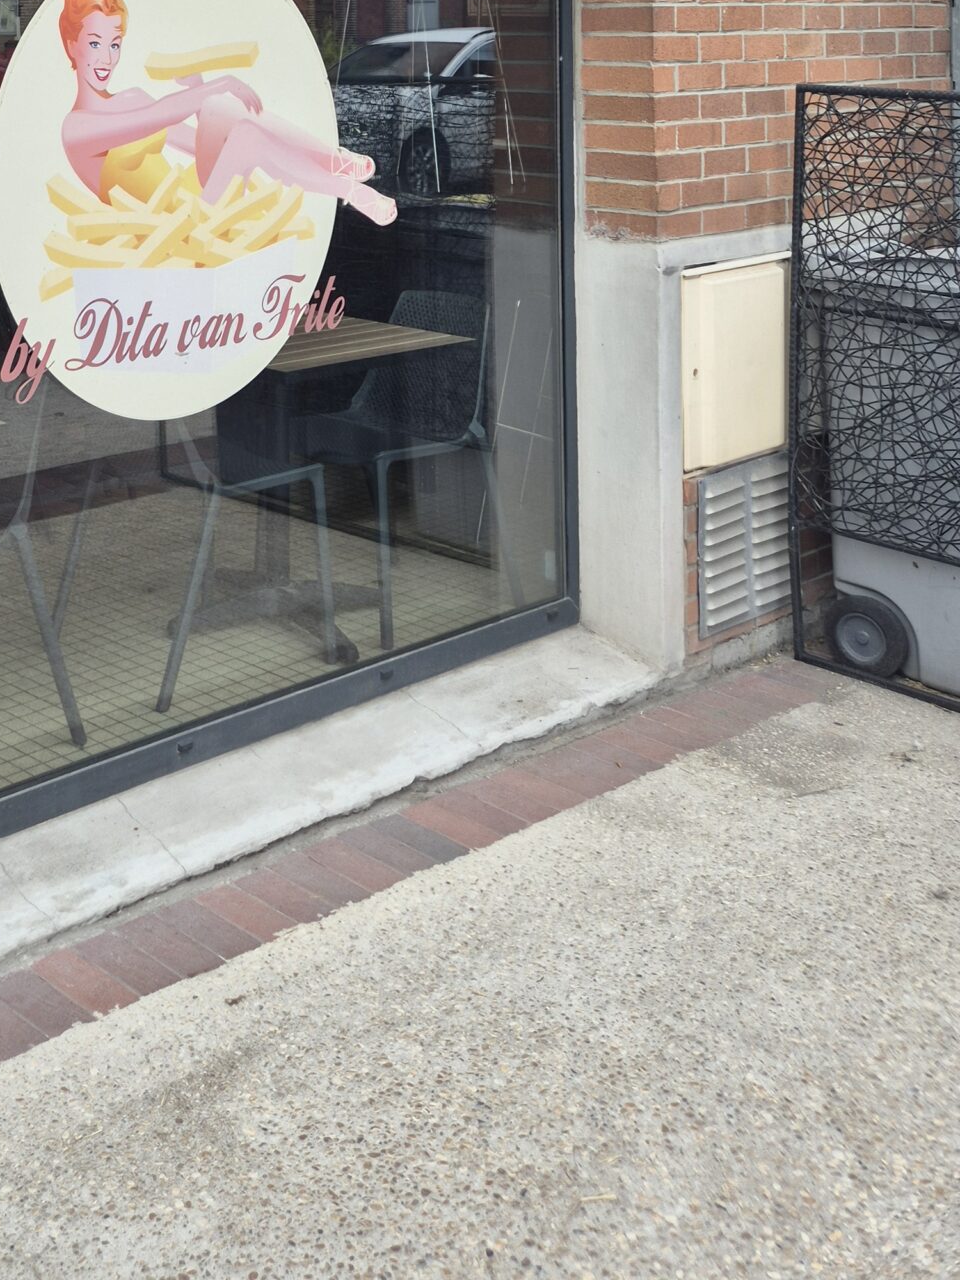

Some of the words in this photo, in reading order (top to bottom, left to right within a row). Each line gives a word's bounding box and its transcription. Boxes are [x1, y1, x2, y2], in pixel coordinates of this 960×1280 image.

[0, 317, 56, 404] by
[64, 297, 169, 372] Dita
[175, 311, 247, 354] van
[252, 274, 347, 342] Frite
